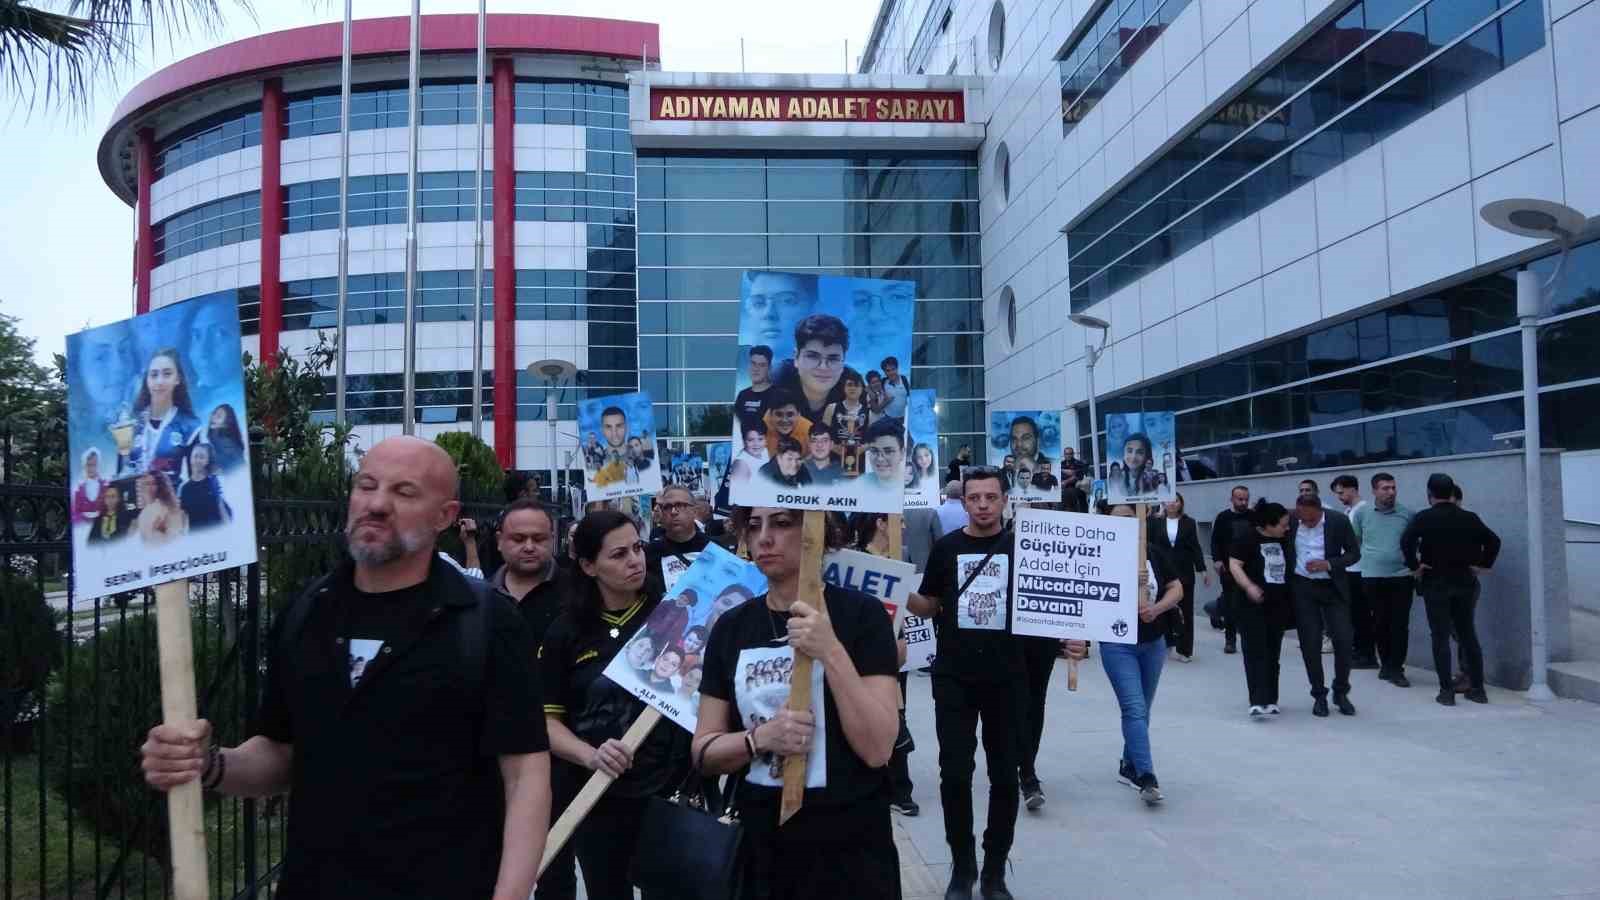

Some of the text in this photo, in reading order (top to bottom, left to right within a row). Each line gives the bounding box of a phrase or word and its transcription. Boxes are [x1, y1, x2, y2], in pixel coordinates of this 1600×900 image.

[660, 96, 955, 120] ADIYAMAN ADALET SARAYI
[776, 494, 857, 507] DORUK AKIN
[1020, 520, 1117, 541] Birlikte Daha
[1020, 538, 1101, 559] Güçlüyüz!
[1019, 557, 1070, 574] Adalet
[822, 562, 901, 598] ALET
[1018, 575, 1119, 600] Mücadeleye
[1017, 596, 1082, 614] Devam!
[658, 700, 680, 717] AKIN
